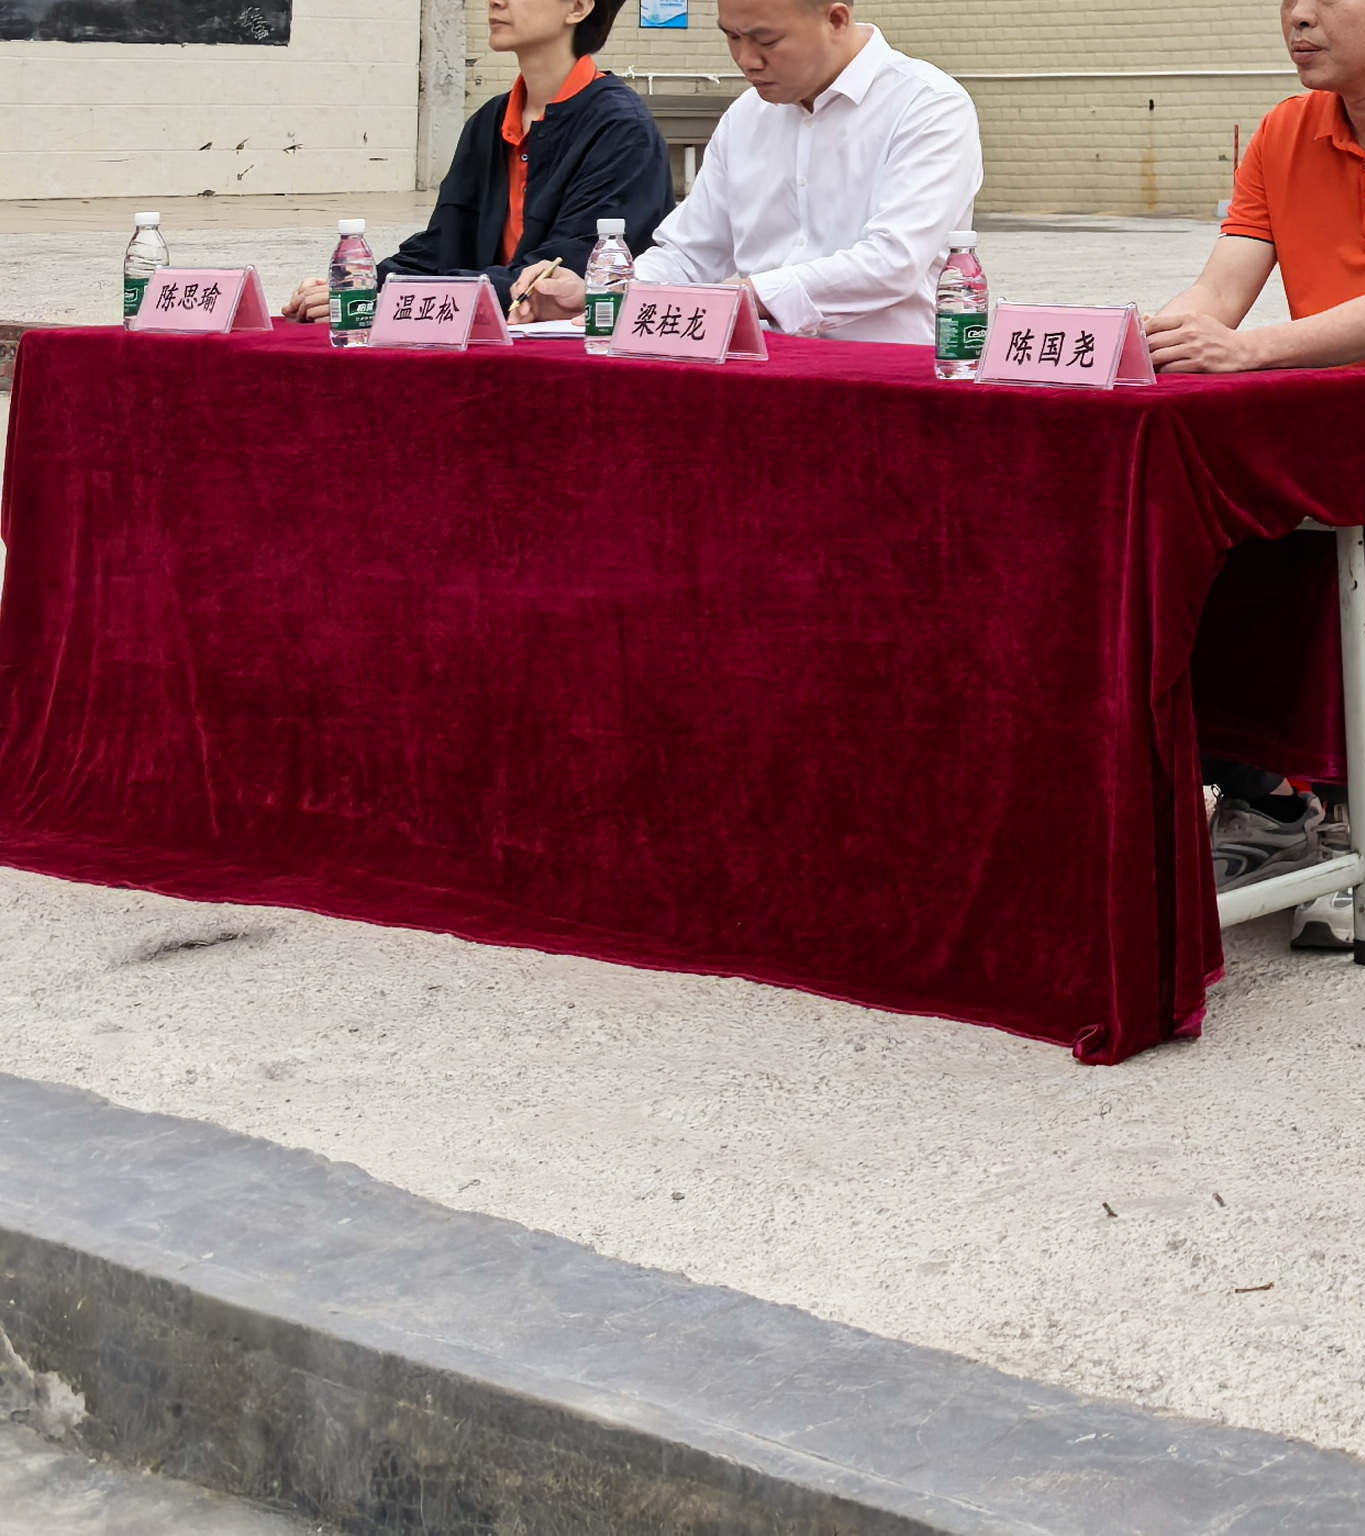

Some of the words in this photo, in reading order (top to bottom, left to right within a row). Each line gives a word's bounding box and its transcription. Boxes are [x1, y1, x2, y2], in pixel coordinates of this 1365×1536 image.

[155, 281, 222, 314] 陈思瑜
[392, 293, 461, 325] 温亚松
[631, 302, 707, 341] 梁柱龙
[1005, 328, 1095, 368] 陈国尧
